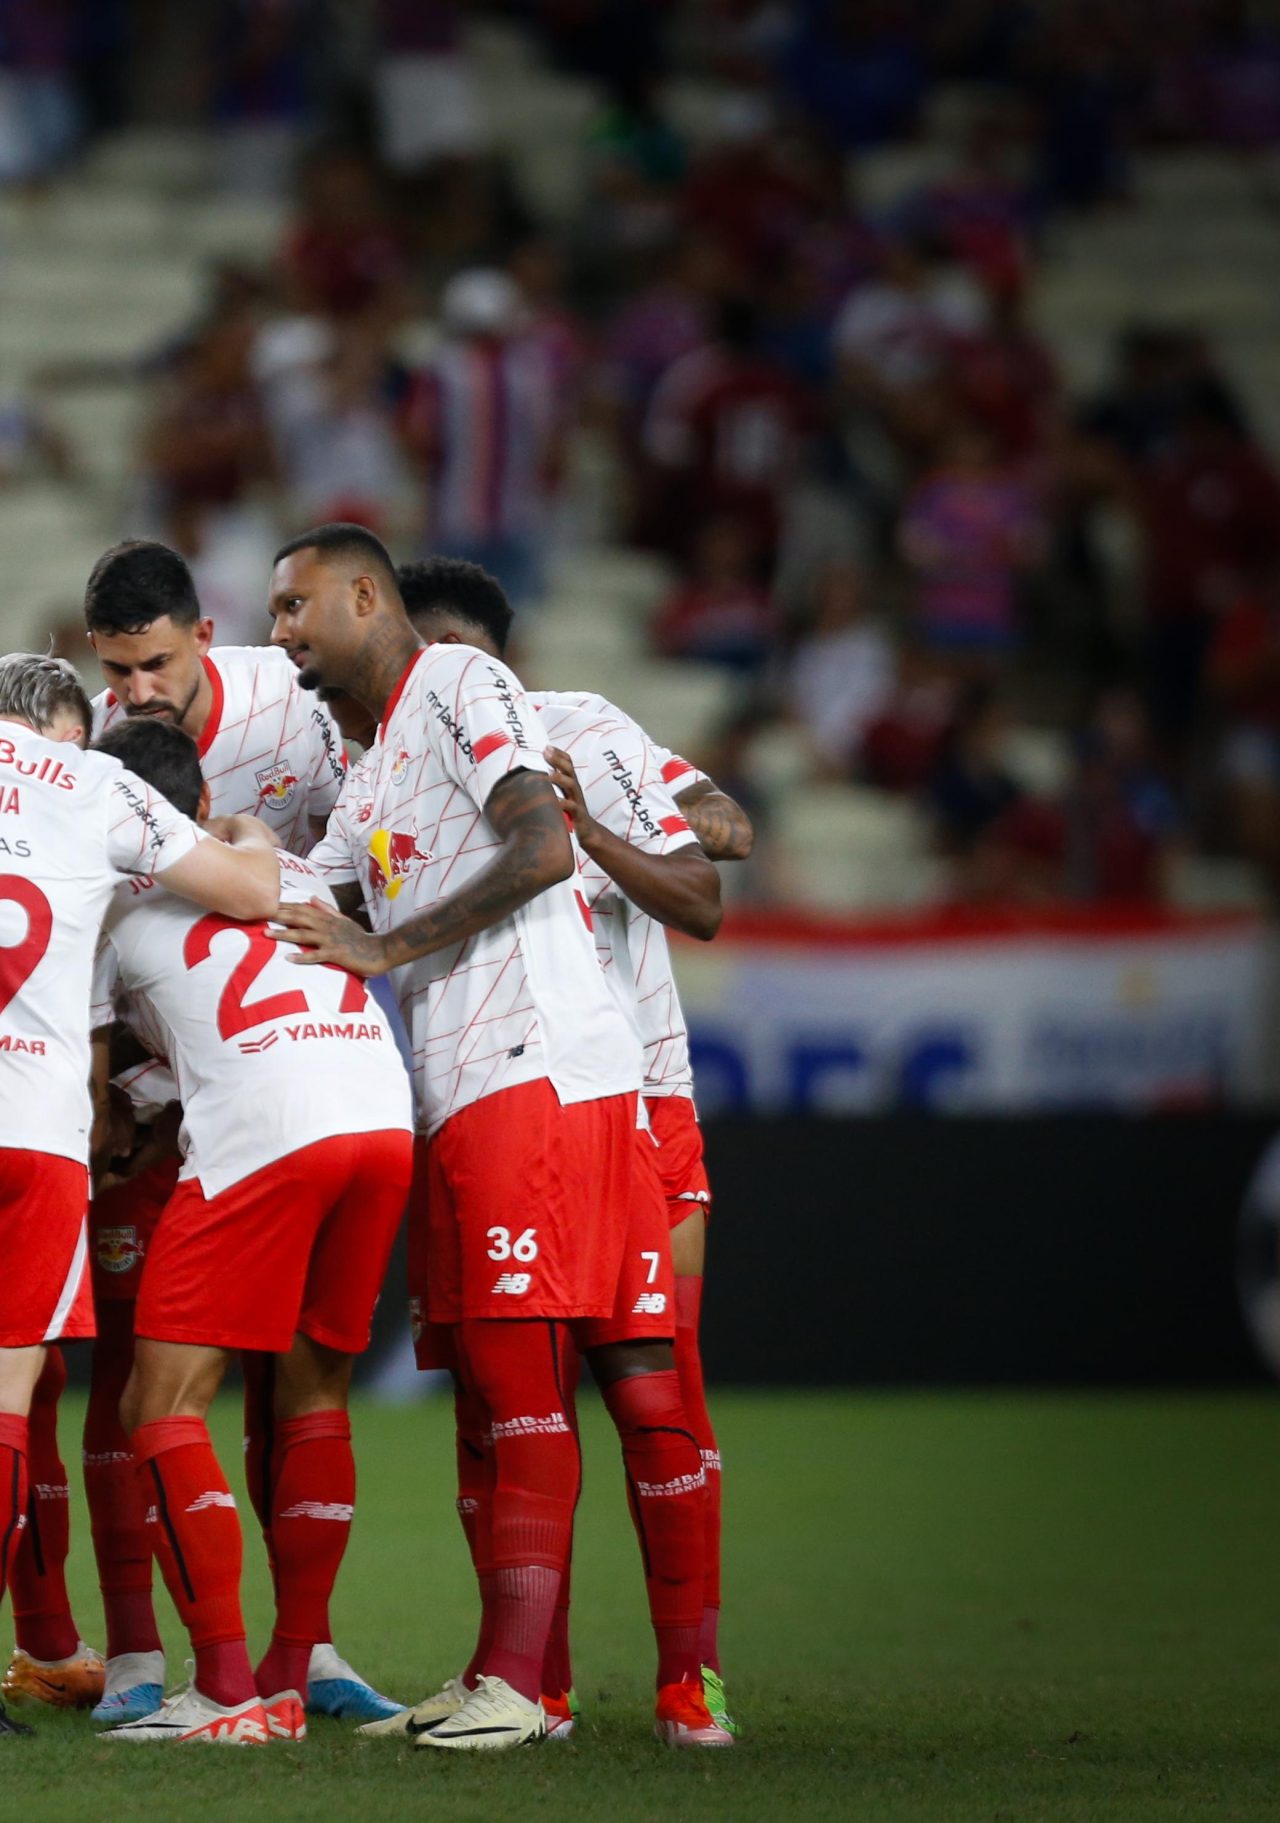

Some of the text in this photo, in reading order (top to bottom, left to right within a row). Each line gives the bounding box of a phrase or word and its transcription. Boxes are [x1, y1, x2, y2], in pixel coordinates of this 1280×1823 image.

[602, 749, 663, 839] mrJack.bet
[283, 1022, 383, 1042] YANMAR
[486, 1226, 539, 1262] 36
[640, 1251, 660, 1285] 7
